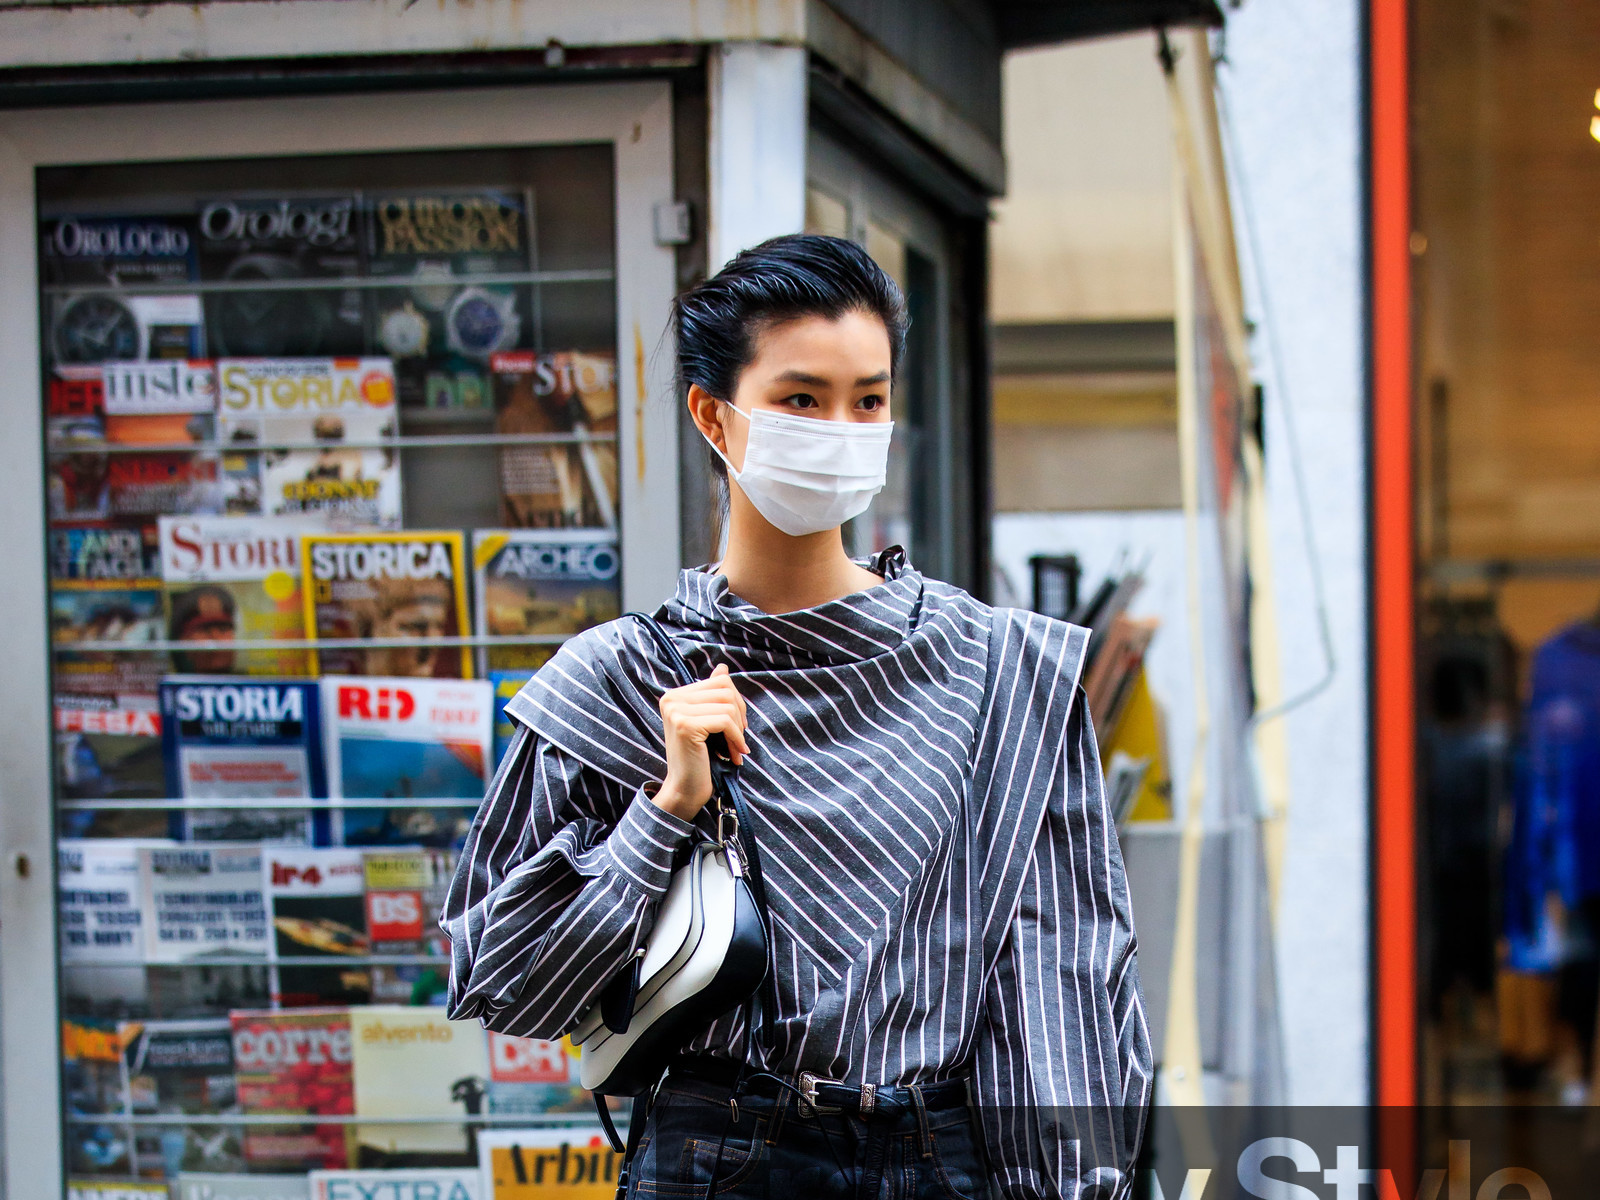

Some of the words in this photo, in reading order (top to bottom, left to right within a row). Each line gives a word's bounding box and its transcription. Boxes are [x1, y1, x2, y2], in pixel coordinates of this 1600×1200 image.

[201, 199, 352, 246] Orologi
[222, 366, 363, 410] STORIA
[312, 542, 452, 580] STORICA
[499, 544, 619, 580] ARCHEO
[176, 686, 303, 722] STORIA
[361, 1021, 454, 1043] alvento
